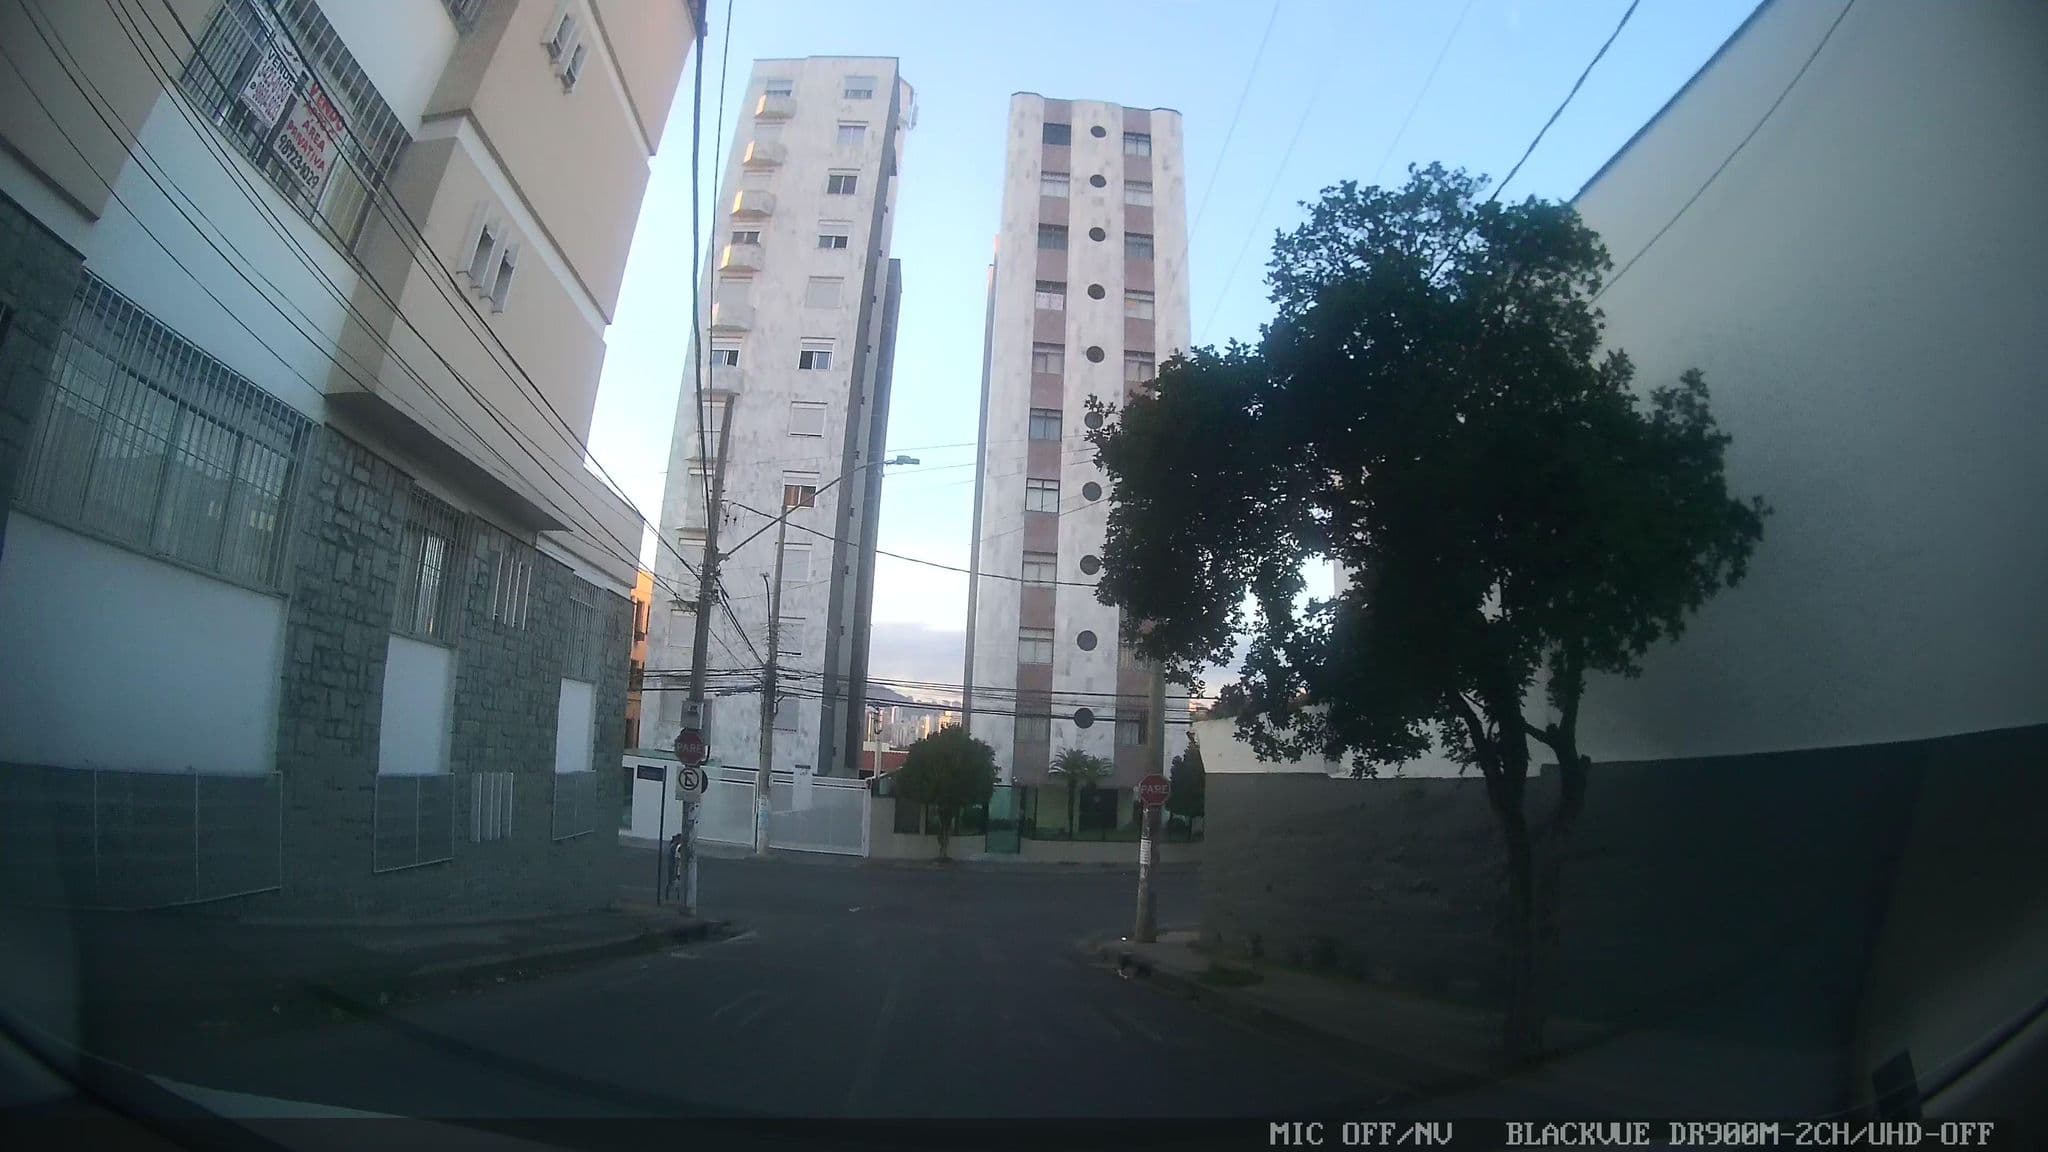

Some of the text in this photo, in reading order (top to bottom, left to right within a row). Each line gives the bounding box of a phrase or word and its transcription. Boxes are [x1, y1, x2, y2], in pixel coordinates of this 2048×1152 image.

[310, 81, 344, 132] VENDO
[286, 119, 325, 171] PRIVATIVA
[302, 118, 325, 152] ÁREA
[679, 744, 702, 753] PARE
[1141, 784, 1168, 793] PARE
